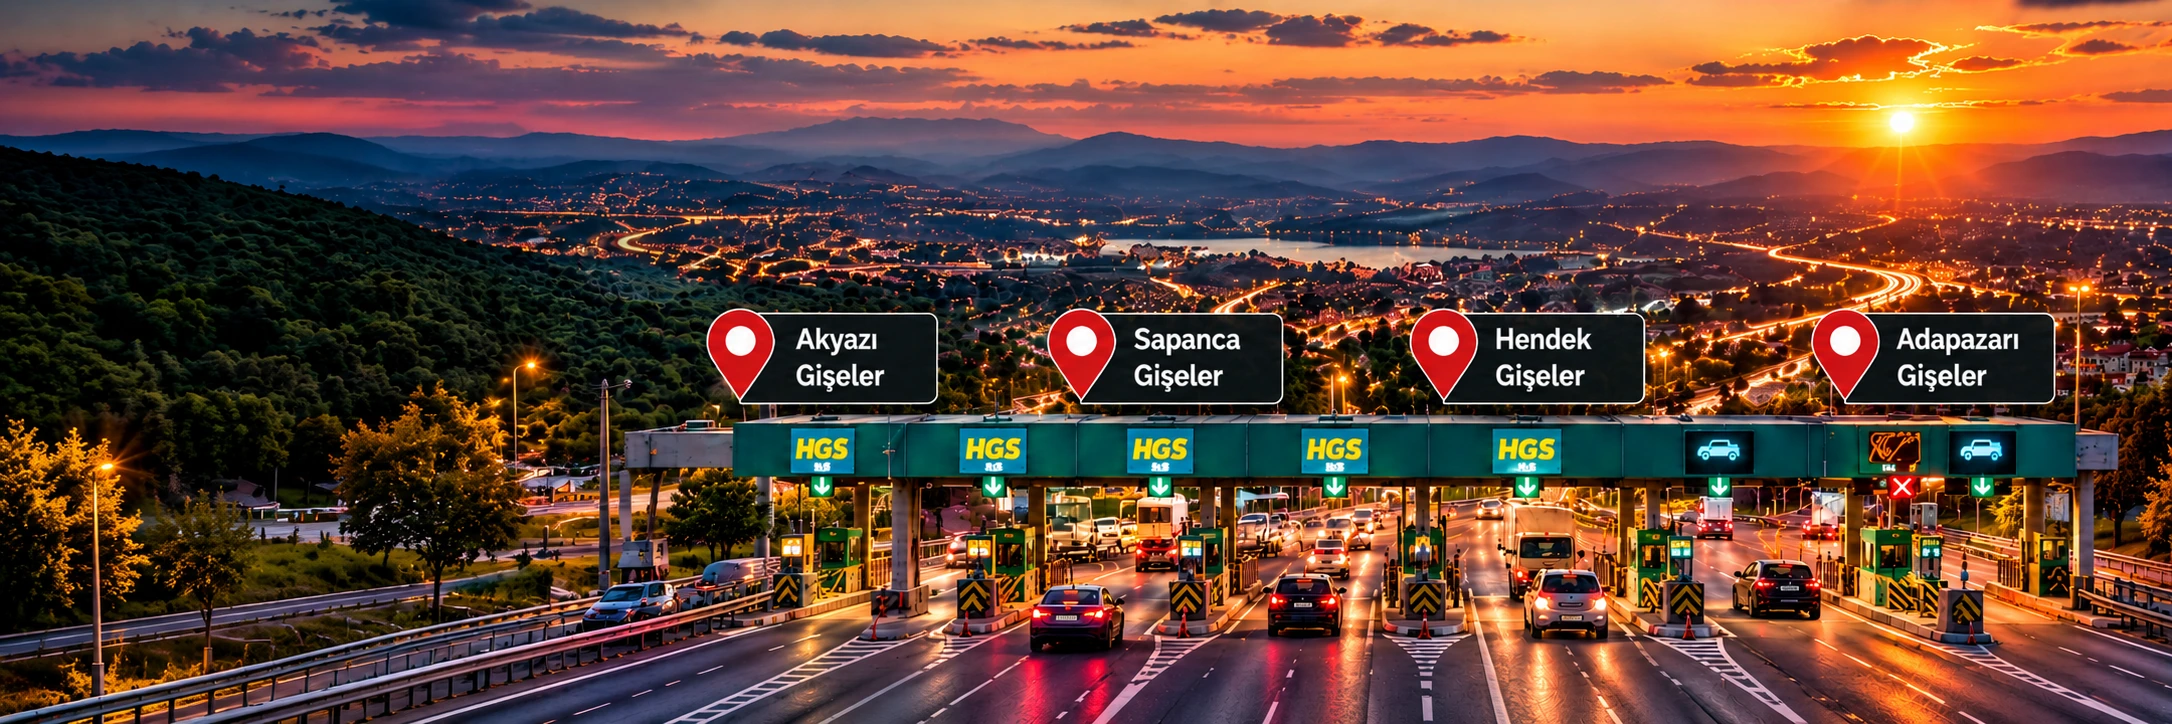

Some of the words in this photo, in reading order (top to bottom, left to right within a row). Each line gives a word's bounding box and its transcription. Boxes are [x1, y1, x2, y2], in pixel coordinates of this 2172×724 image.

[795, 437, 849, 460] HGS
[965, 437, 1021, 460] HGS
[1132, 437, 1188, 460] HGS
[1306, 437, 1362, 460] HGS
[1498, 437, 1556, 460] HGS
